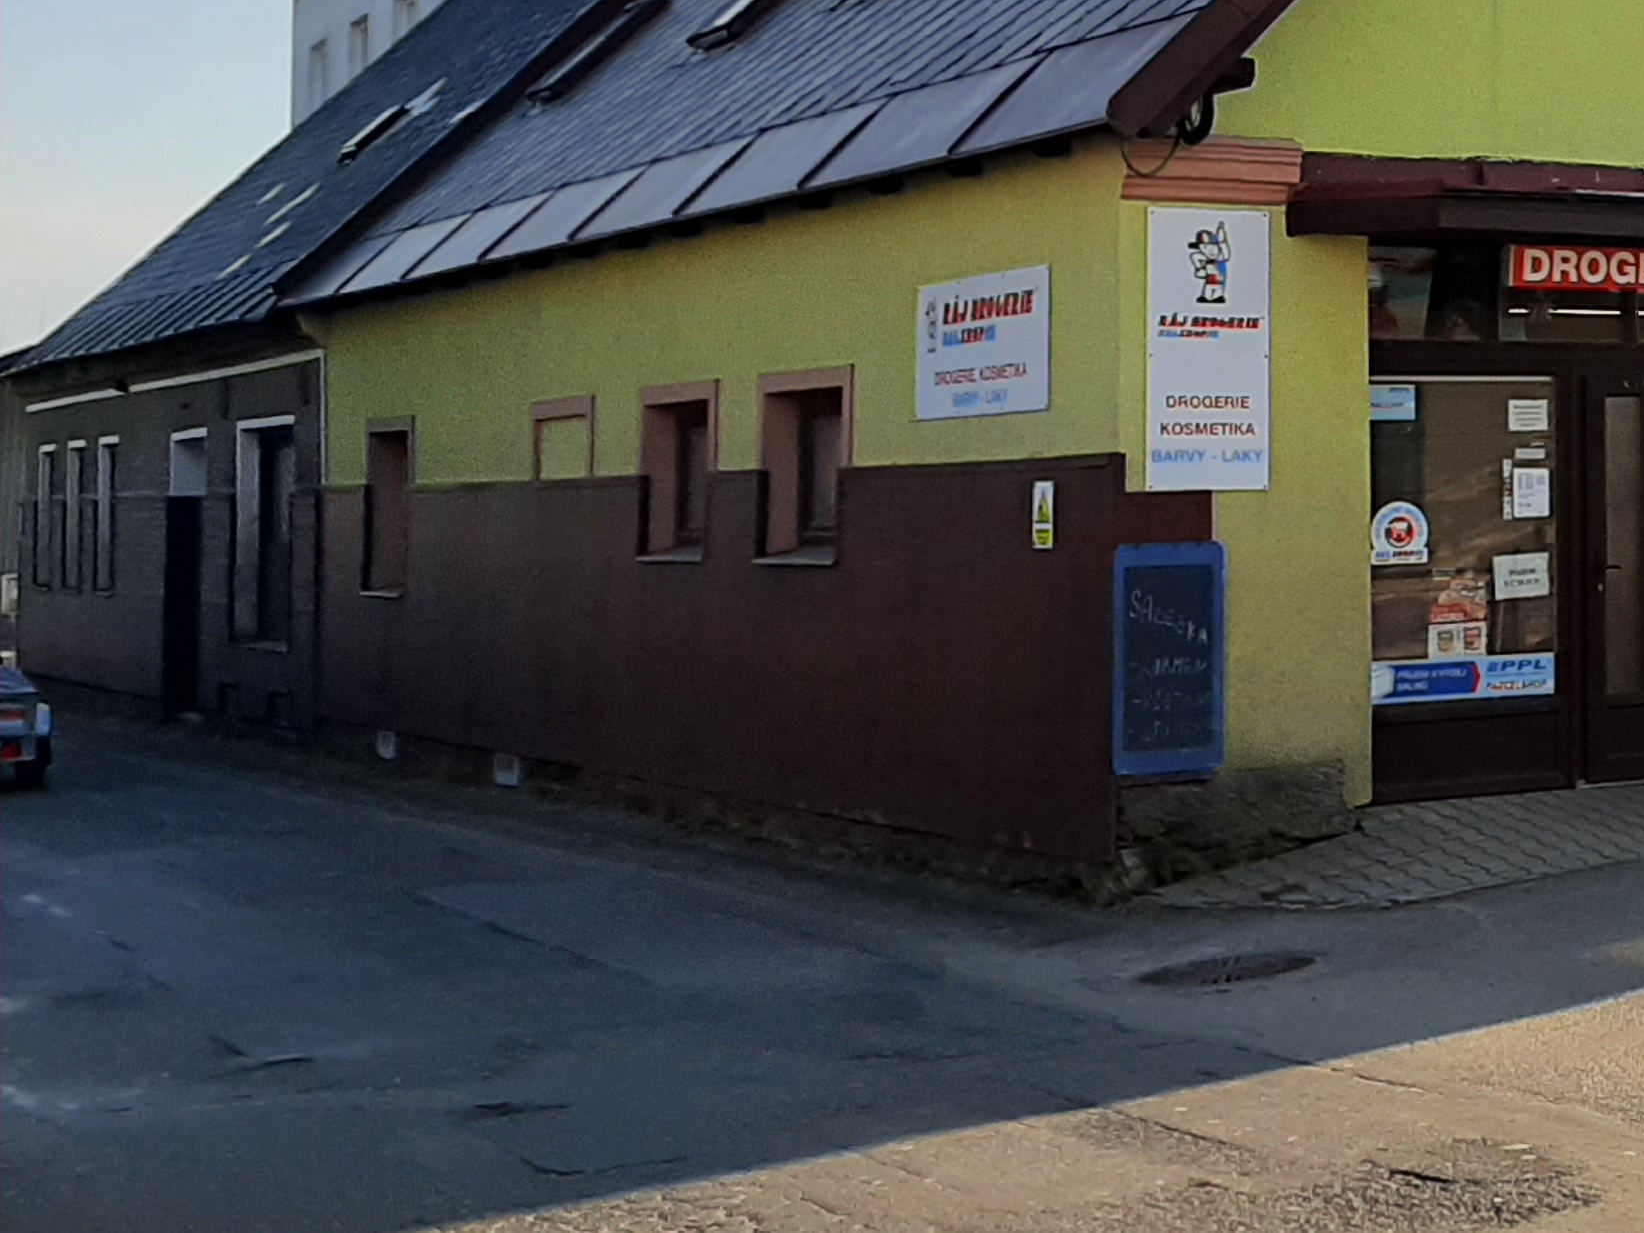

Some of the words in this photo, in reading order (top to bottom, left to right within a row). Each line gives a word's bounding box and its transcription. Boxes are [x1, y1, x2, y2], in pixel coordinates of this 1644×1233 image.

[1165, 395, 1250, 409] DROGERIE
[1160, 422, 1256, 436] KOSMETIKA
[1151, 449, 1206, 463] BARVY
[1222, 449, 1263, 463] LAKY
[1500, 659, 1547, 672] PPL
